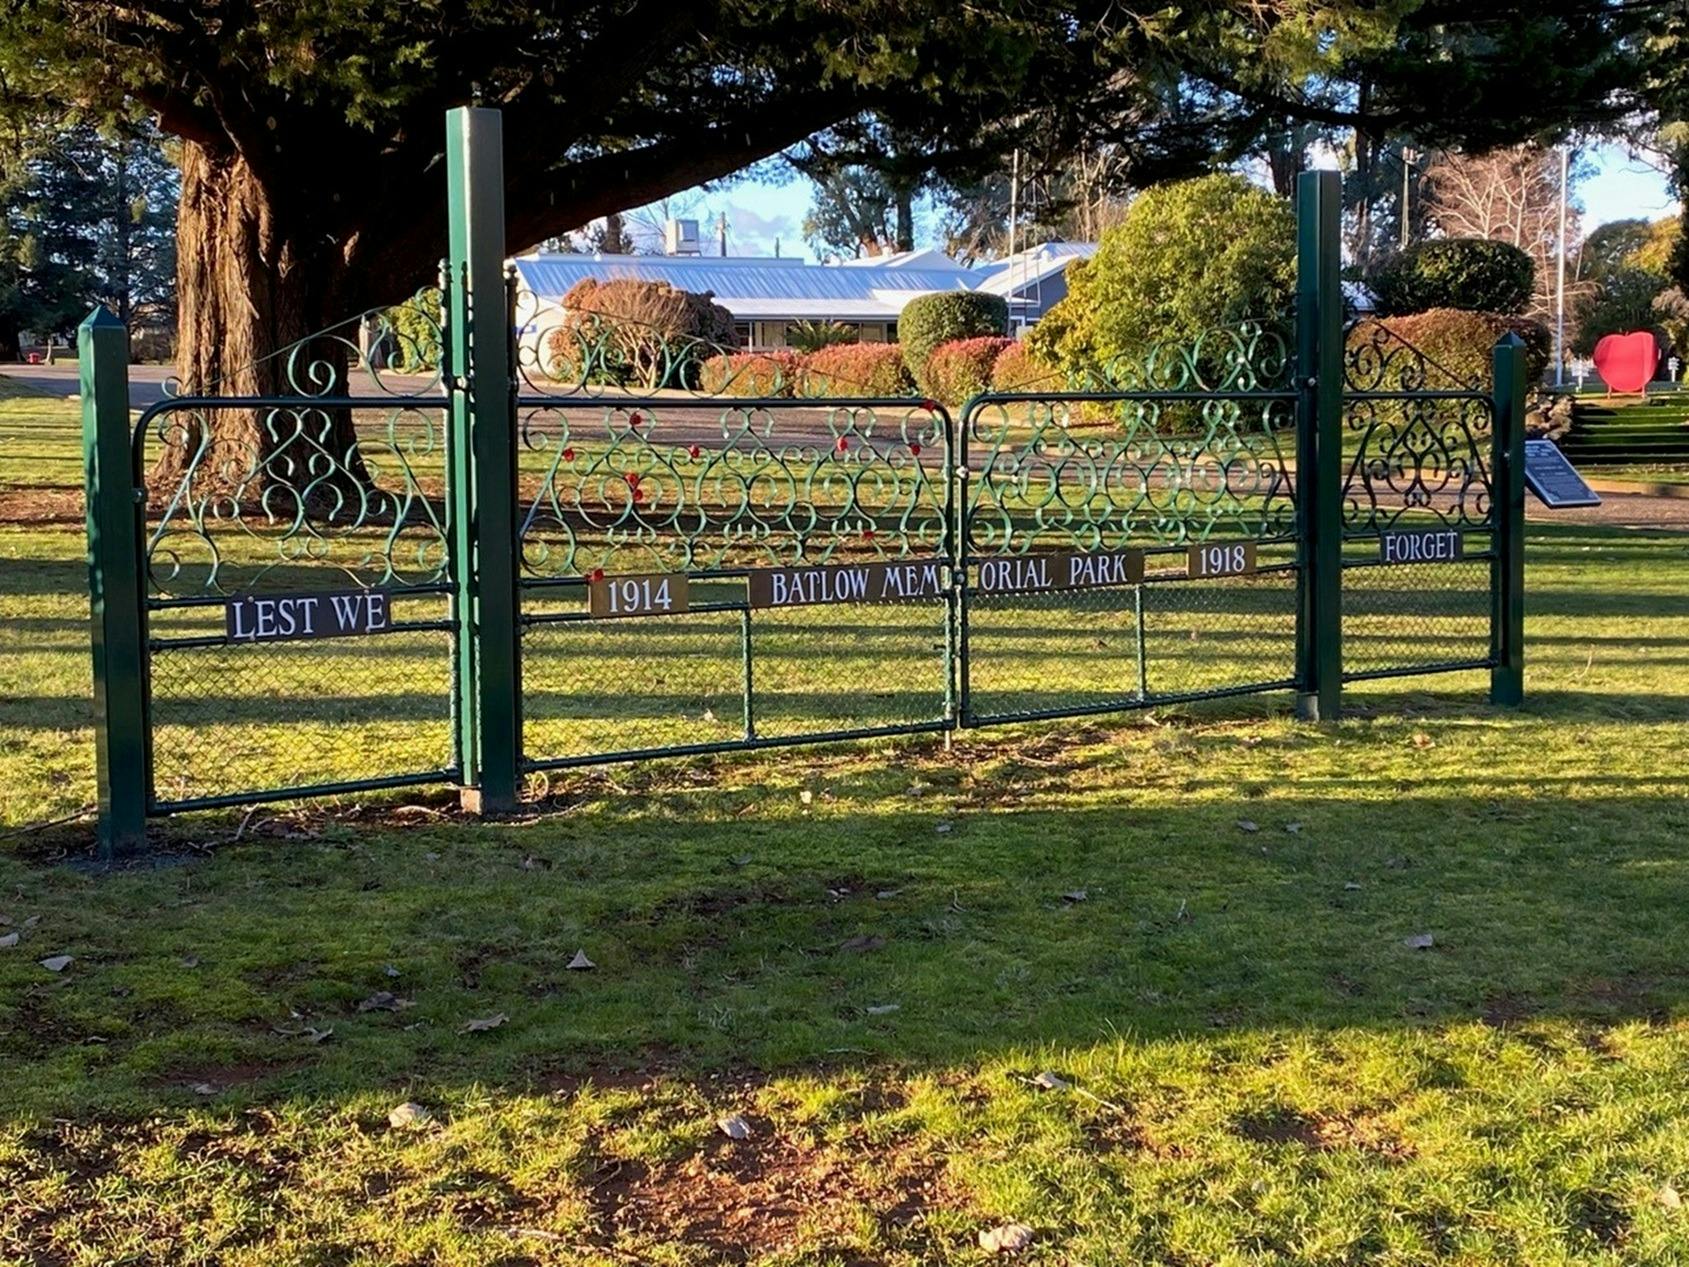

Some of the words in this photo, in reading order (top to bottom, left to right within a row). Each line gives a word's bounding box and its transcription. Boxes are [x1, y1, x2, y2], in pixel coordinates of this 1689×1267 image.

[1200, 545, 1246, 575] 1918
[1385, 532, 1457, 562] FORGET
[772, 568, 871, 605] BATLOW
[881, 565, 940, 598] MEM
[980, 558, 1052, 591] ORIAL
[1069, 554, 1128, 586] PARK
[607, 578, 672, 613] 1914
[232, 597, 317, 639] LEST
[330, 593, 386, 633] WE
